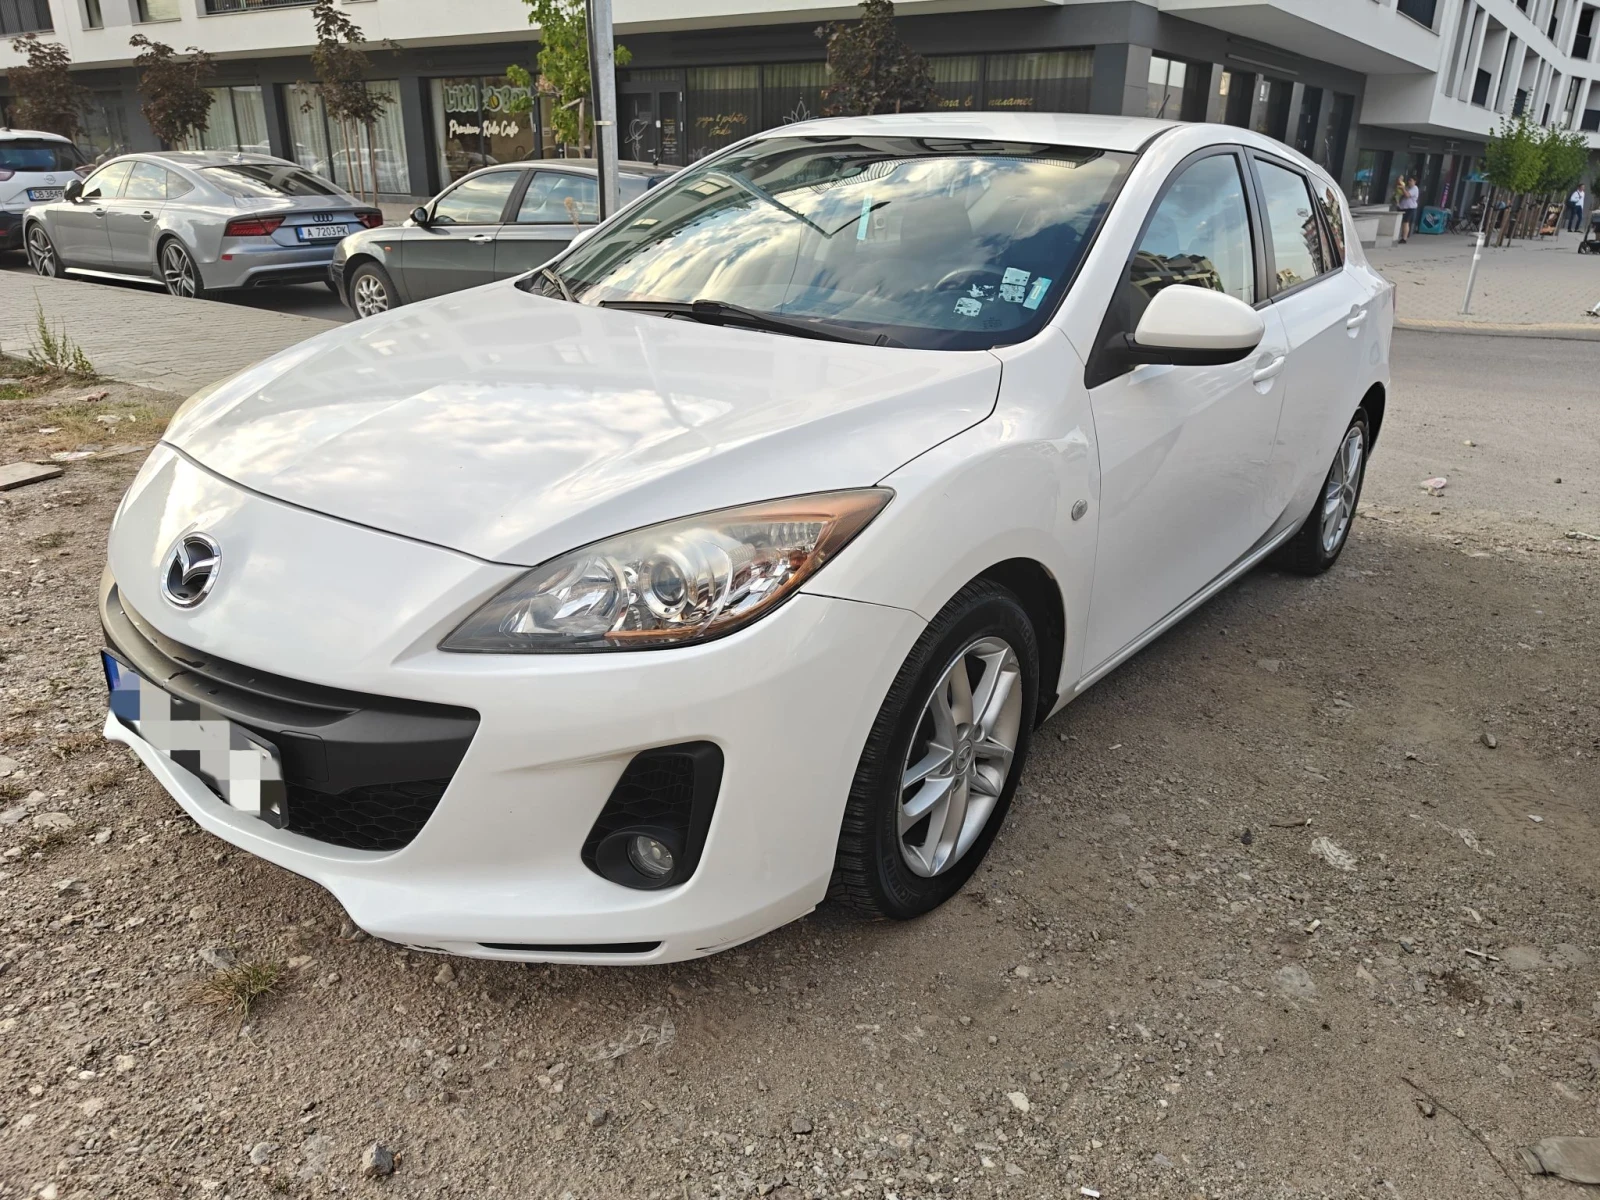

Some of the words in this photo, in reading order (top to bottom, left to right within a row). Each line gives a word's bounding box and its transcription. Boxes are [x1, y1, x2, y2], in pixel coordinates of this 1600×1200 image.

[988, 96, 1034, 107] пилатес
[449, 119, 481, 138] Premium
[307, 228, 314, 238] A
